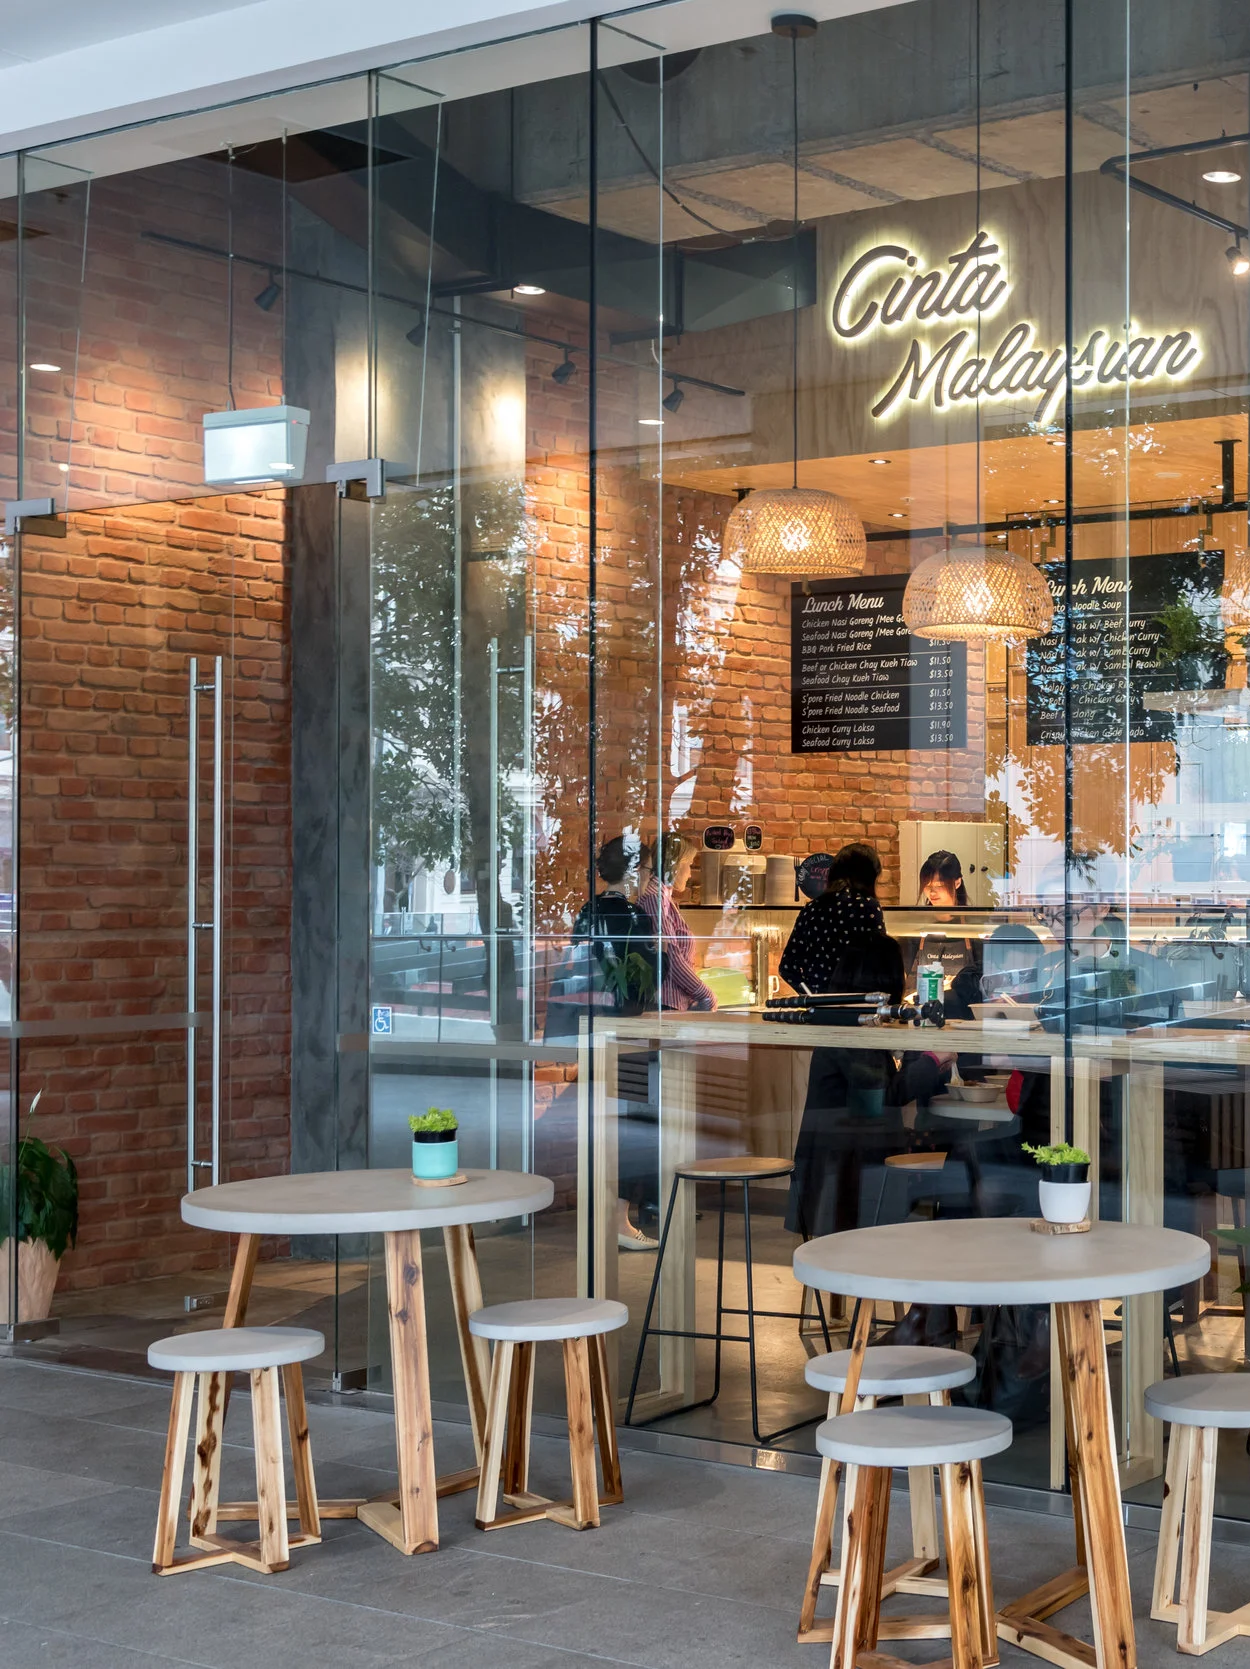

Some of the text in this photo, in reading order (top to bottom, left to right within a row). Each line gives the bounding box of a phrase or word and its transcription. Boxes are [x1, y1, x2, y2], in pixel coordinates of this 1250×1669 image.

[832, 231, 1007, 338] Cinta
[871, 322, 1198, 422] Malaysian
[802, 593, 884, 613] Lunch Menu
[1101, 600, 1122, 611] Soup
[801, 618, 830, 629] Chicken
[831, 617, 848, 627] Nasi
[849, 616, 874, 627] Goreng
[1103, 617, 1124, 629] Beef
[1128, 619, 1147, 630] urry
[801, 630, 830, 642] Seafood
[831, 630, 848, 640] Nasi
[849, 629, 874, 640] Goreng
[1040, 634, 1058, 646] Nasi
[1137, 631, 1160, 644] Curry
[801, 645, 817, 654] BBQ
[819, 643, 835, 653] Pork
[836, 641, 855, 652] Fried
[856, 641, 872, 651] Rice
[1129, 646, 1151, 658] Curry
[801, 661, 819, 673] Beef
[829, 660, 858, 671] Chicken
[880, 657, 899, 668] Kueh
[900, 657, 918, 667] Tiaw
[928, 656, 952, 666] $11.50
[801, 674, 830, 686] Seafood
[831, 673, 851, 686] Chay
[851, 672, 870, 683] Kueh
[928, 669, 954, 679] $13.50
[824, 691, 844, 702] Fried
[844, 690, 869, 701] Noodle
[870, 689, 900, 701] Chicken
[928, 688, 952, 698] $11.50
[824, 704, 844, 715] Fried
[844, 703, 869, 714] Noodle
[870, 702, 901, 714] Seafood
[929, 701, 954, 711] $13.50
[801, 720, 951, 736] Chicken Curry Laksa $11.90
[1129, 726, 1145, 737] ado
[801, 733, 954, 749] Seafood Curry Laksa $13.50
